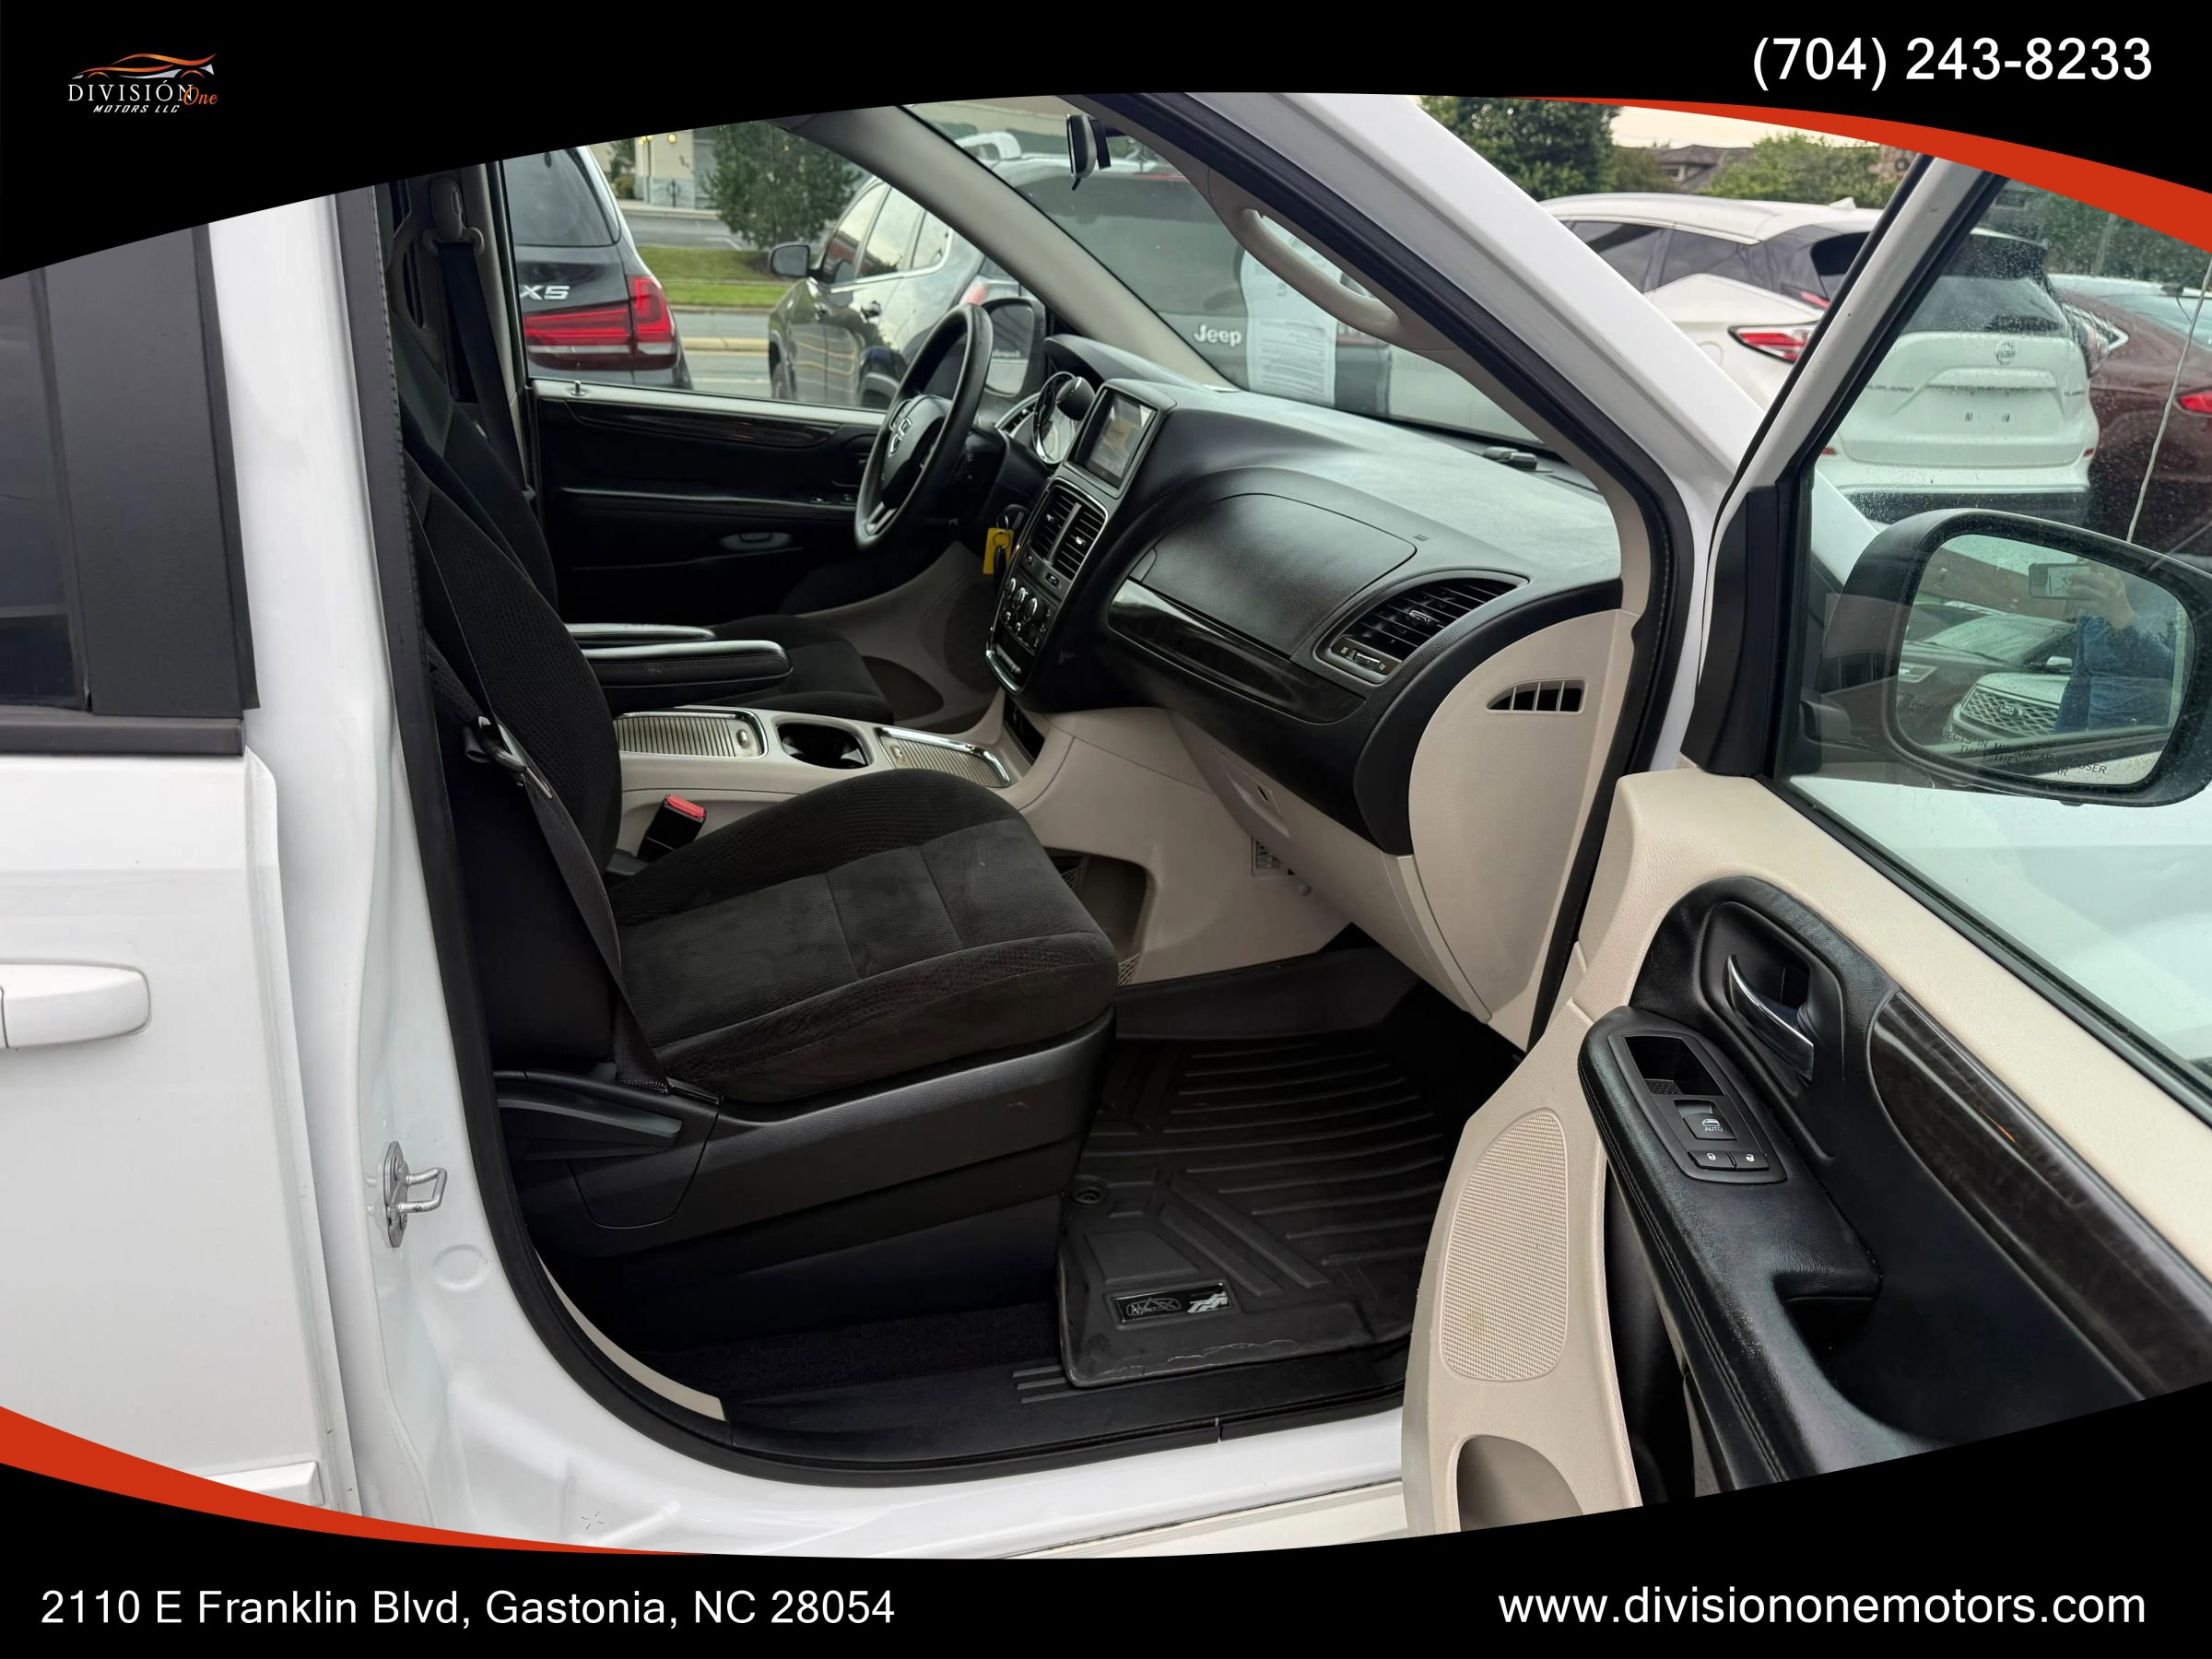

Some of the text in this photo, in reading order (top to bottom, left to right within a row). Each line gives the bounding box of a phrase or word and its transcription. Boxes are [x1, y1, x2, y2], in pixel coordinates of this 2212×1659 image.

[519, 284, 571, 300] X5
[1193, 324, 1242, 347] Jeep
[1977, 738, 1989, 747] IN
[1994, 742, 2033, 758] MIROR
